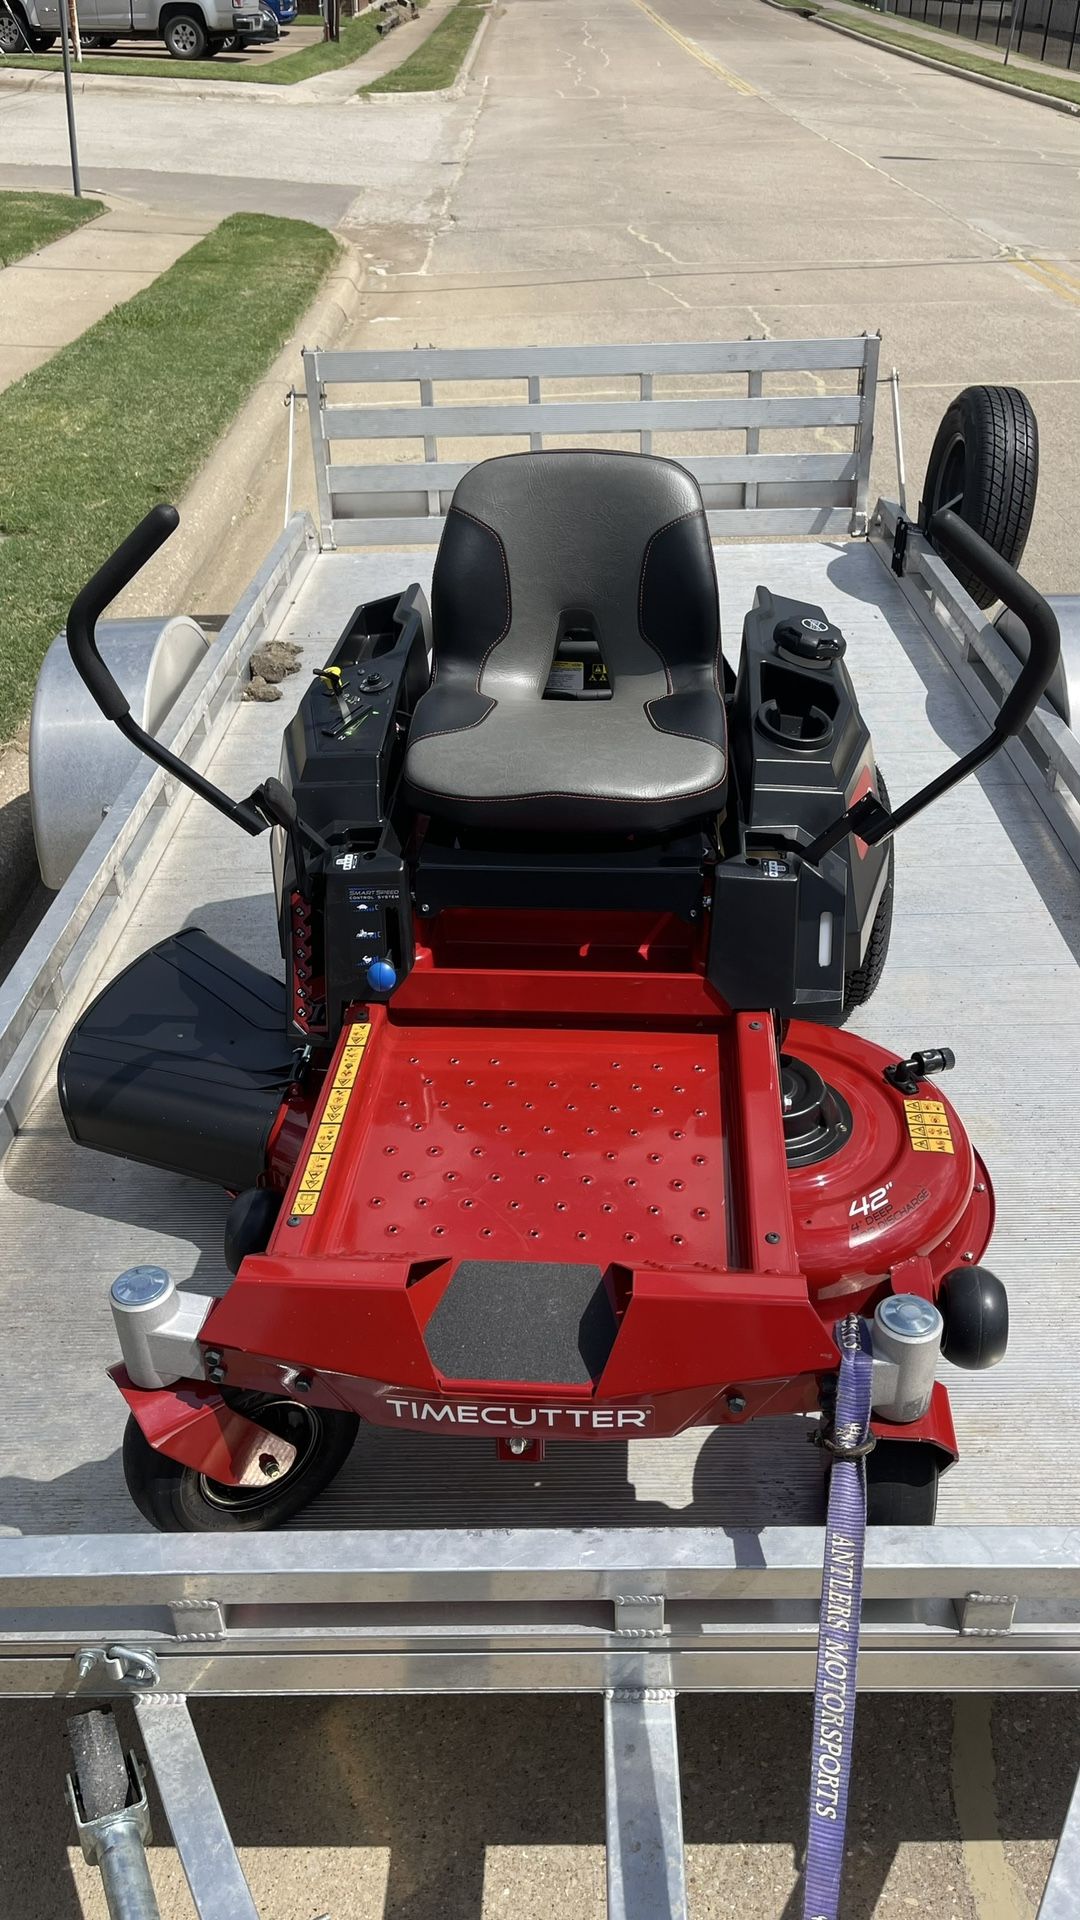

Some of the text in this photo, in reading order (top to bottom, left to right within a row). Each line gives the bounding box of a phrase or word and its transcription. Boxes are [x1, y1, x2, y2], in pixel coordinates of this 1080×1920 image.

[849, 1181, 893, 1216] 42"
[865, 1204, 893, 1226] DEEP
[877, 1188, 929, 1228] DISCHARGE
[386, 1399, 647, 1428] TIMECUTTER
[815, 1532, 856, 1821] ANTLERS MOTORSPORTS
